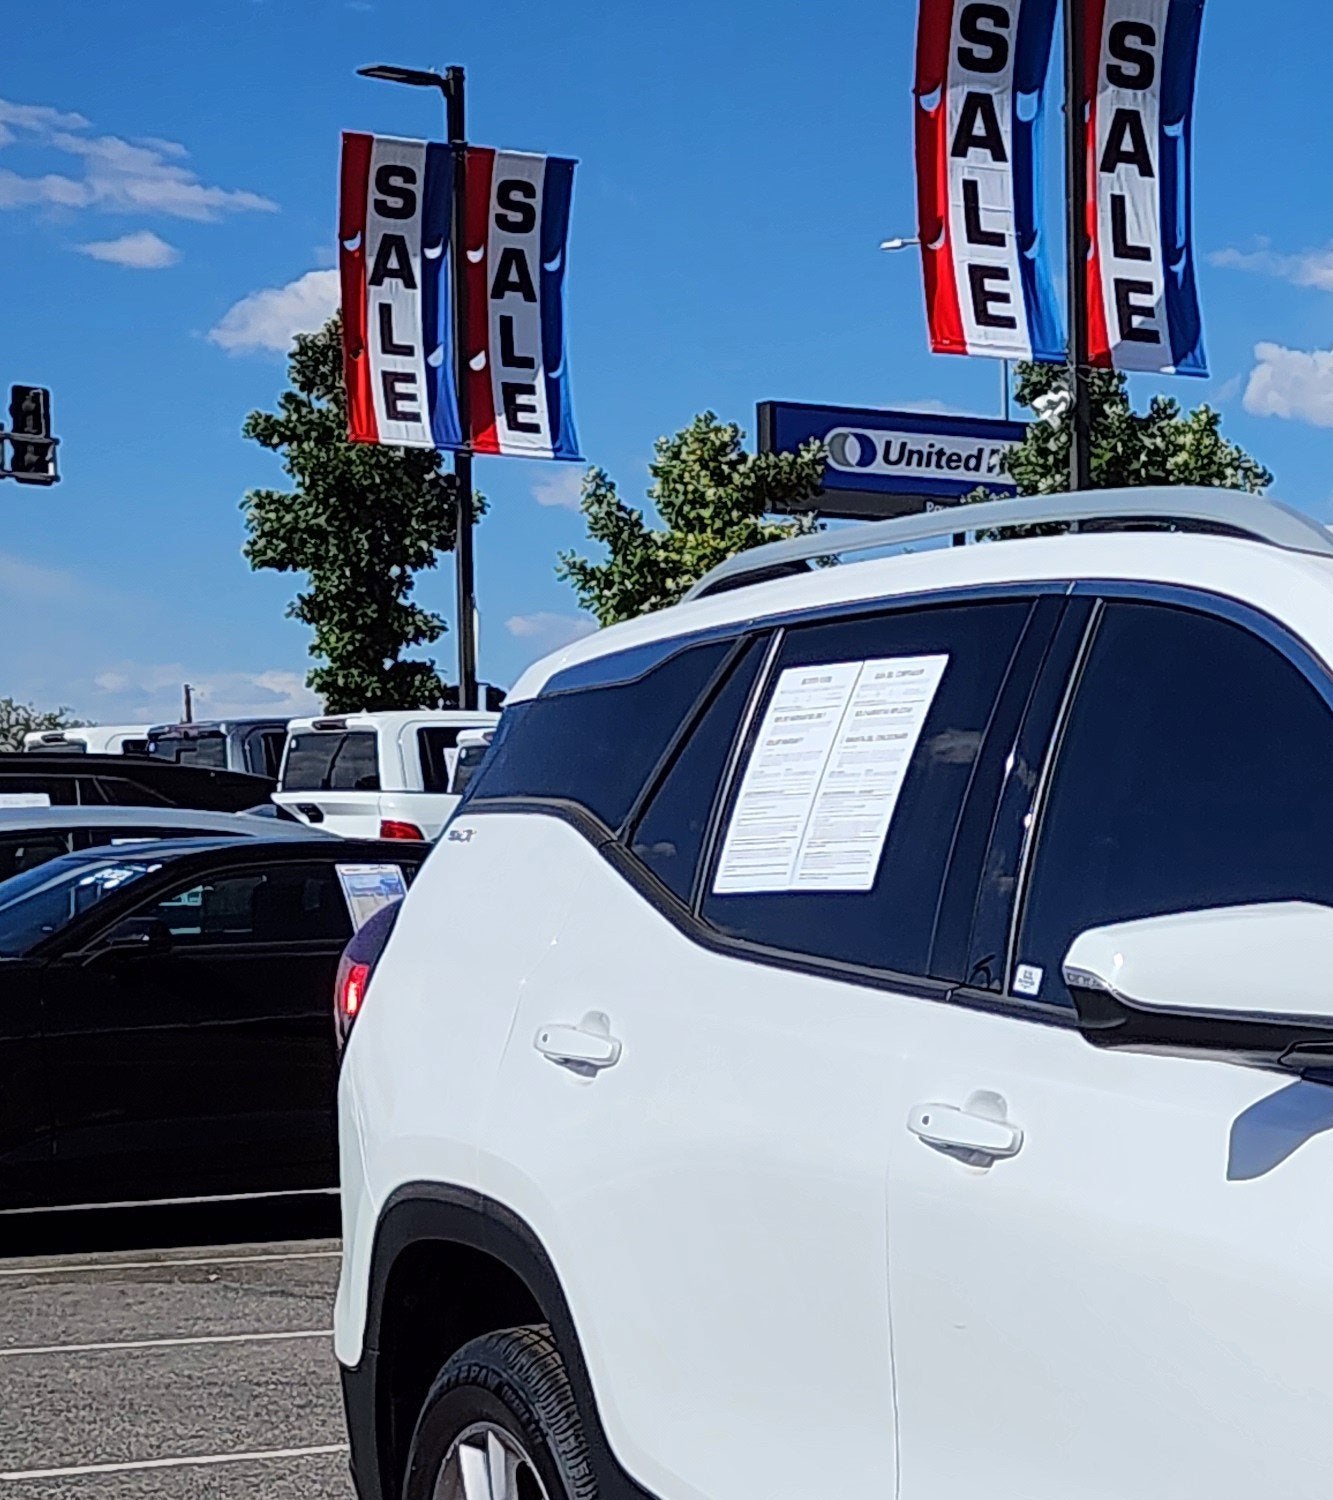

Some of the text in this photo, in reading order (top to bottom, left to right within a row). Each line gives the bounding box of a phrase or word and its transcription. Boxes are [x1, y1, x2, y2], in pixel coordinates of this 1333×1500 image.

[367, 164, 422, 424] SALE
[949, 2, 1018, 331] SALE
[1098, 19, 1162, 346] SALE
[489, 178, 542, 434] SALE
[881, 439, 985, 473] United
